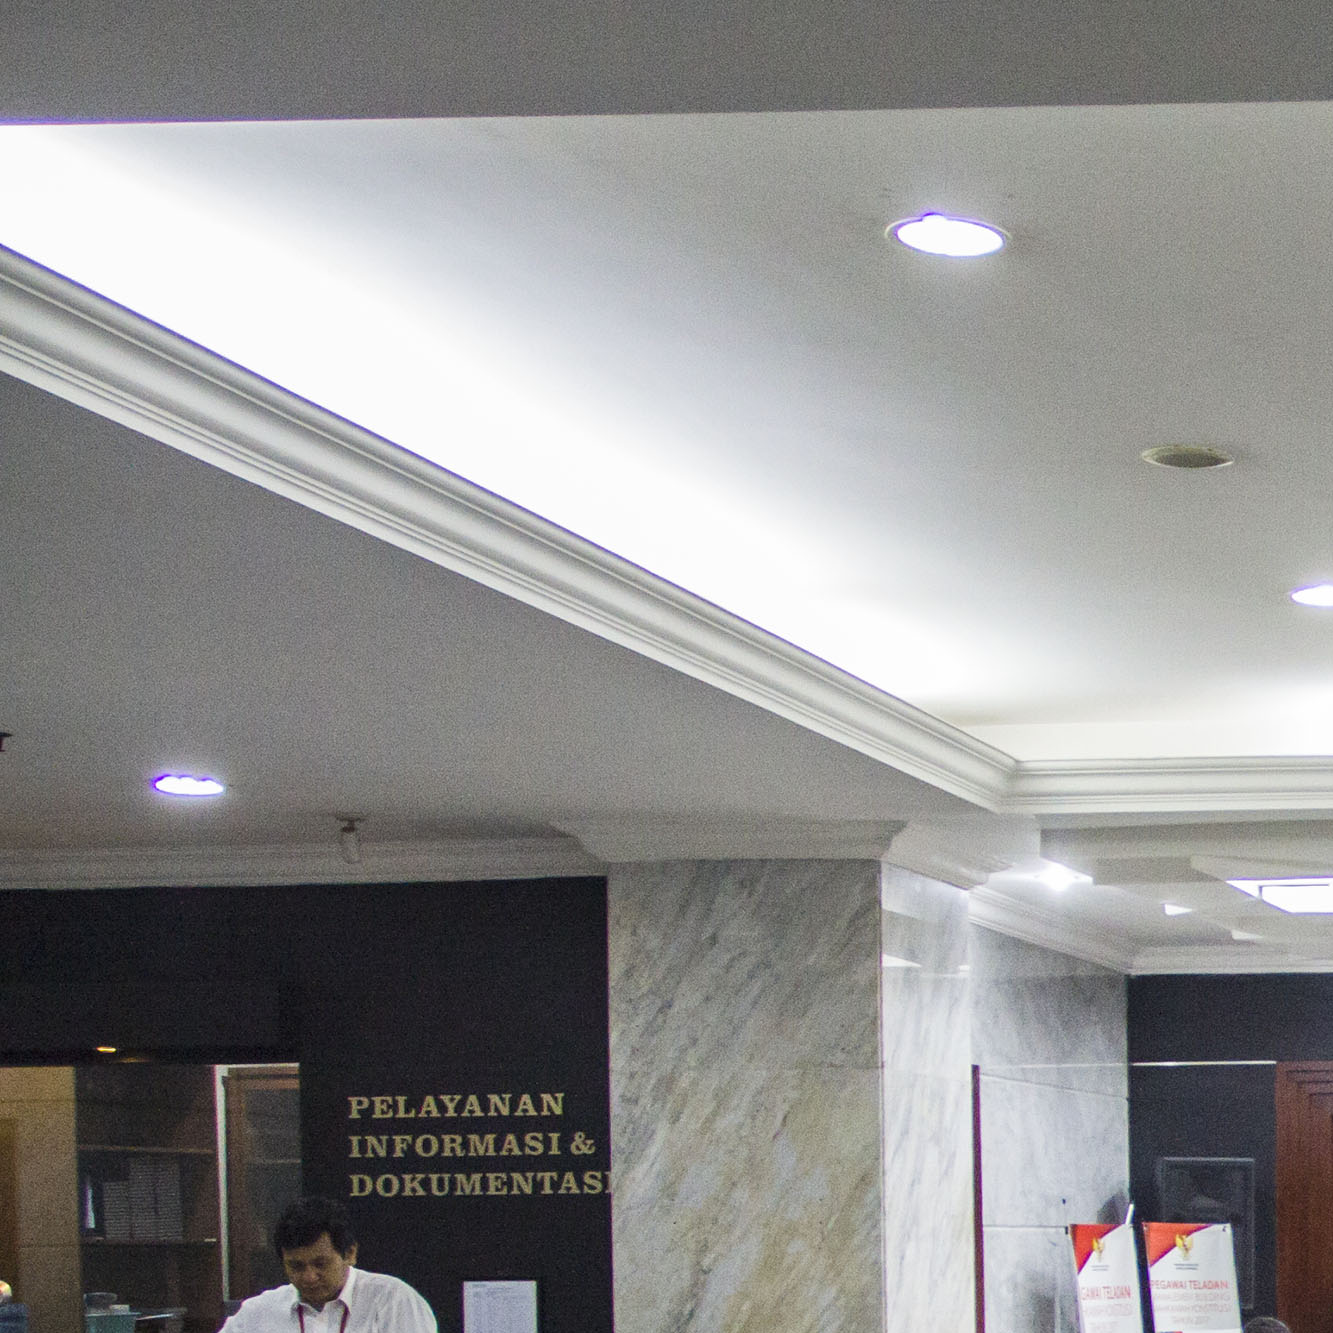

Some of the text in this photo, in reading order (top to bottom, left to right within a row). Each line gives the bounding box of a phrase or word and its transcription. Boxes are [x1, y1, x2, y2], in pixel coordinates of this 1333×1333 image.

[348, 1093, 565, 1118] PELAYANAN
[348, 1131, 596, 1158] INFORMASI &
